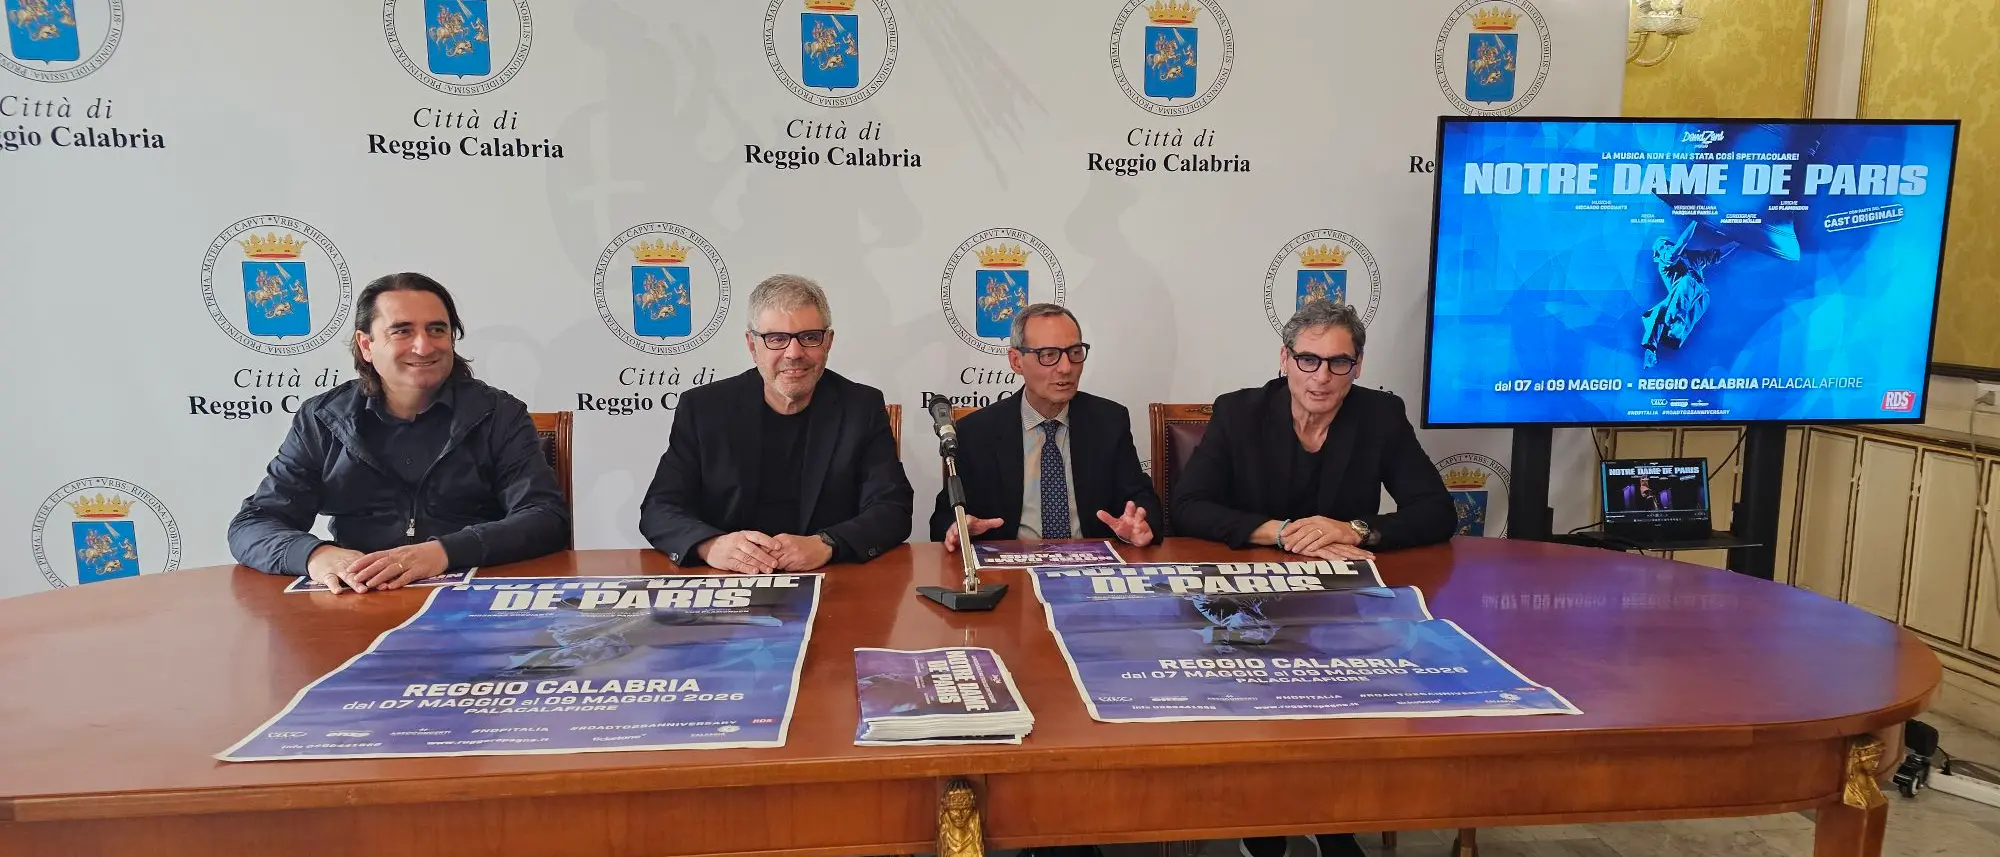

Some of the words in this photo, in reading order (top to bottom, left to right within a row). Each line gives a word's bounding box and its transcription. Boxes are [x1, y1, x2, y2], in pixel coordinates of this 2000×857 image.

[0, 96, 71, 118] Città
[86, 98, 112, 119] di
[413, 107, 480, 130] Città
[494, 110, 518, 130] di
[51, 126, 166, 149] Calabria
[786, 118, 847, 140] Città
[858, 121, 881, 141] di
[1128, 128, 1182, 147] Città
[1194, 129, 1215, 147] di
[367, 134, 452, 161] Reggio
[459, 136, 564, 159] Calabria
[744, 144, 820, 170] Reggio
[828, 146, 922, 168] Calabria
[1602, 152, 1612, 160] LA
[1614, 152, 1645, 160] MUSICA
[1646, 152, 1665, 160] NON
[1672, 152, 1688, 160] MAI
[1690, 152, 1714, 160] STATA
[1716, 152, 1734, 161] COSÌ
[1736, 152, 1800, 161] SPETTACOLARE!
[1087, 152, 1156, 176] Reggio
[1163, 154, 1250, 172] Calabria
[1464, 162, 1599, 195] NOTRE
[1612, 163, 1728, 196] DAME
[1742, 164, 1792, 196] DE
[1804, 164, 1929, 196] PARIS
[1824, 217, 1850, 229] CAST
[1852, 208, 1905, 225] ORIGINALE
[234, 368, 302, 388] Città
[314, 368, 339, 388] di
[619, 367, 681, 386] Città
[692, 367, 715, 386] di
[1495, 380, 1512, 392] dal
[1514, 380, 1532, 392] 07
[1534, 380, 1544, 391] al
[1546, 380, 1565, 391] 09
[1568, 379, 1622, 391] MAGGIO
[1638, 378, 1688, 390] REGGIO
[1690, 378, 1758, 390] CALABRIA
[1762, 377, 1863, 389] PALACALAFIORE
[188, 395, 272, 420] Reggio
[576, 392, 654, 416] Reggio
[1886, 391, 1909, 406] RDS
[1609, 468, 1636, 476] NOTRE
[1674, 466, 1700, 474] PARIS
[1092, 576, 1154, 594] DE
[1168, 575, 1325, 594] PARIS
[489, 590, 564, 610] DE
[578, 588, 752, 610] PARIS
[946, 650, 976, 682] NOTRE
[1122, 672, 1148, 680] dal
[1152, 671, 1178, 679] 07
[1186, 670, 1268, 679] MAGGIO
[1274, 670, 1288, 678] al
[1327, 668, 1408, 676] MAGGIO
[1158, 658, 1266, 670] REGGIO
[1272, 658, 1420, 669] CALABRIA
[403, 681, 528, 698] REGGIO
[535, 678, 700, 694] CALABRIA
[932, 674, 962, 704] PARIS
[1236, 676, 1370, 684] PALACALAFIORE
[343, 700, 376, 710] dal
[378, 699, 413, 710] 07
[418, 697, 517, 708] MAGGIO
[522, 697, 540, 706] al
[544, 696, 576, 706] 09
[582, 694, 676, 704] MAGGIO
[682, 693, 745, 702] 2026
[464, 704, 620, 714] PALACALAFIORE
